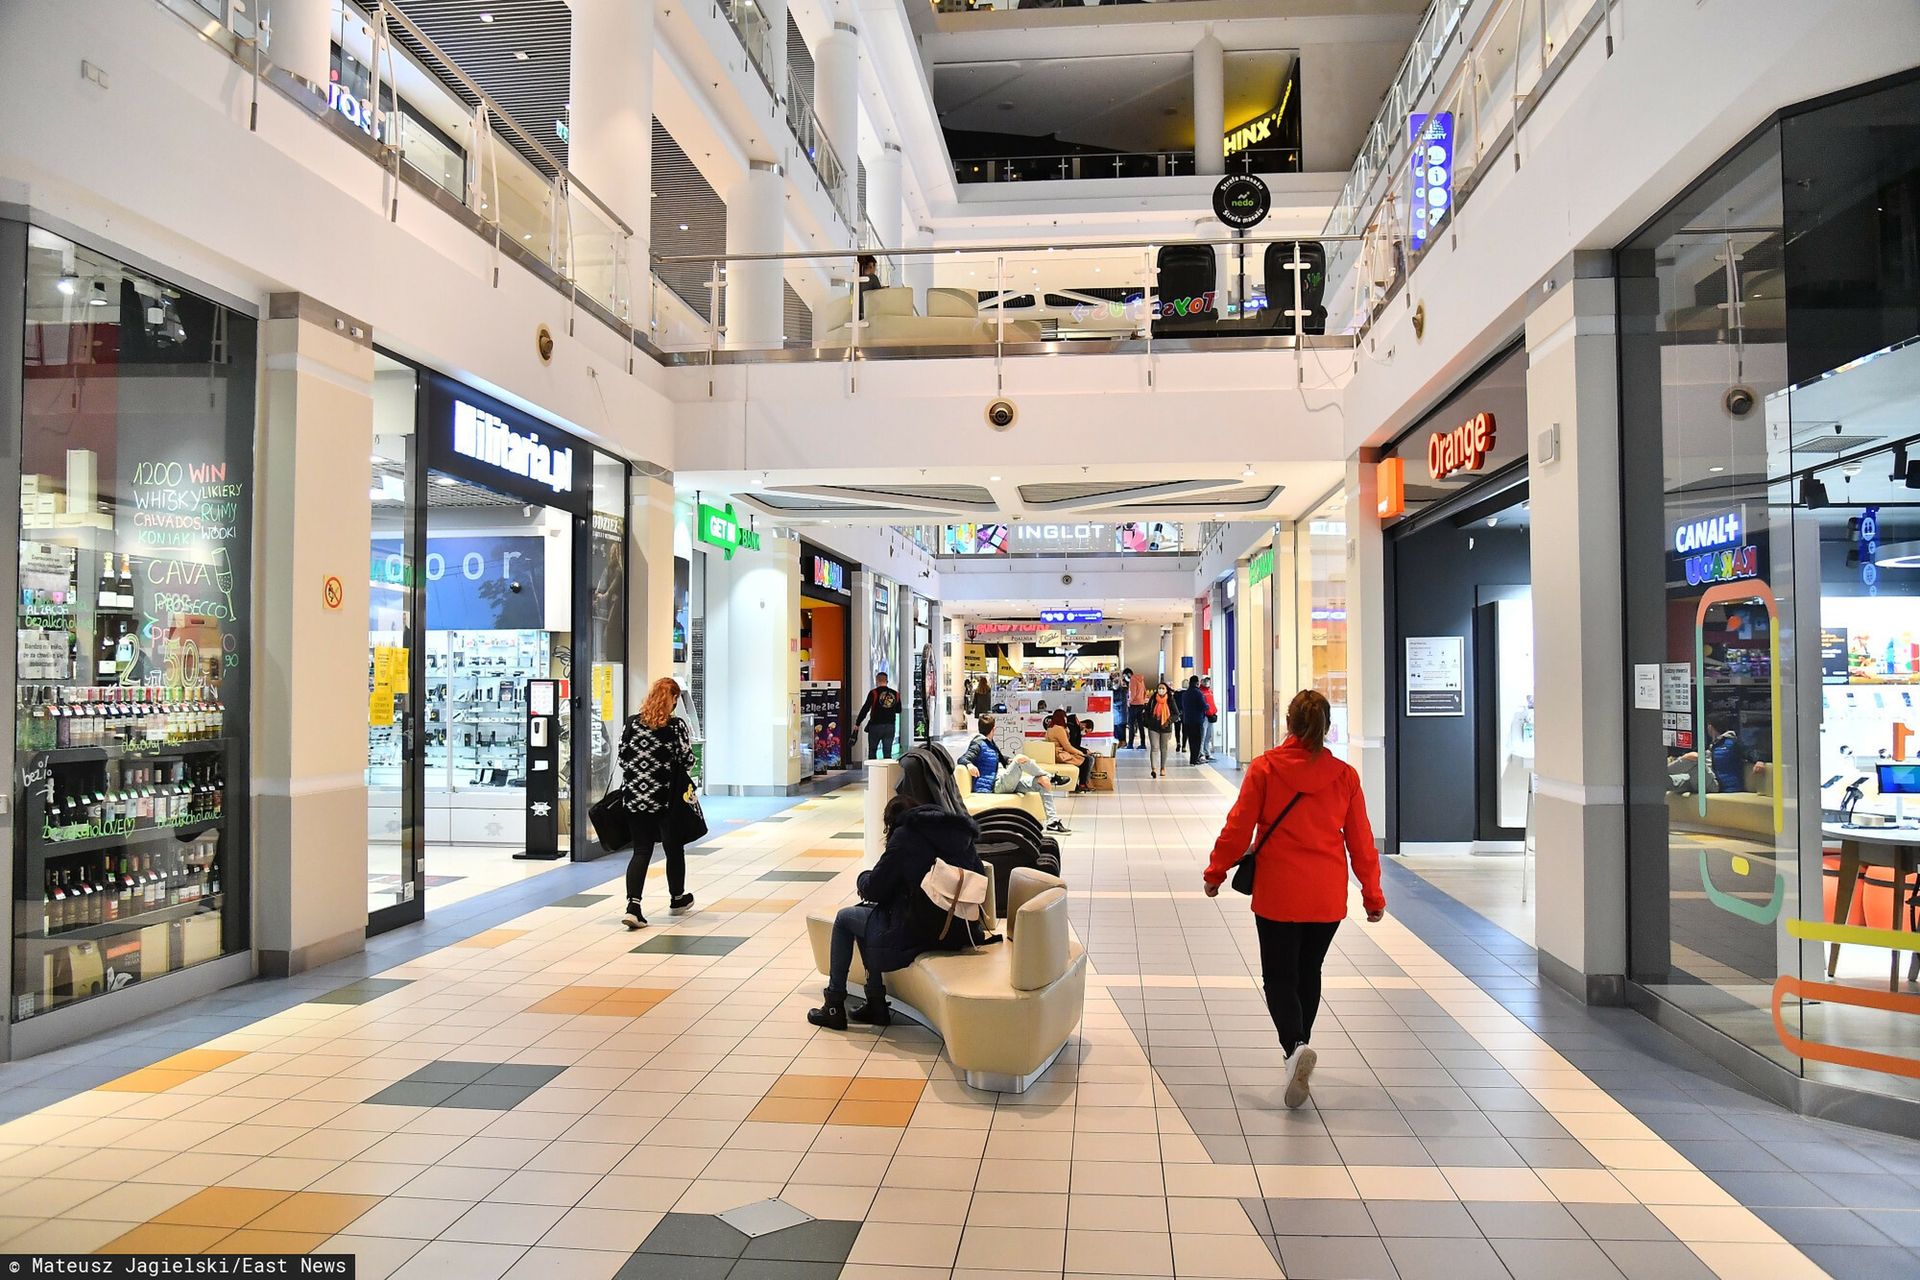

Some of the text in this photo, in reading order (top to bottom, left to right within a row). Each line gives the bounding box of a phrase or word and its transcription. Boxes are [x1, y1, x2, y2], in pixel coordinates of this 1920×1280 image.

[1220, 175, 1240, 191] Strefa
[1222, 209, 1242, 223] Strefa
[1429, 412, 1488, 480] Orange
[133, 461, 227, 486] 1200 WIN
[201, 483, 243, 498] LIKIERY
[133, 512, 202, 530] CALVADOS
[201, 502, 237, 523] RUMY
[138, 530, 196, 545] KONIAKI
[1018, 524, 1105, 539] INGLOT
[1675, 513, 1739, 553] CANAL+
[147, 559, 211, 586] CAVA
